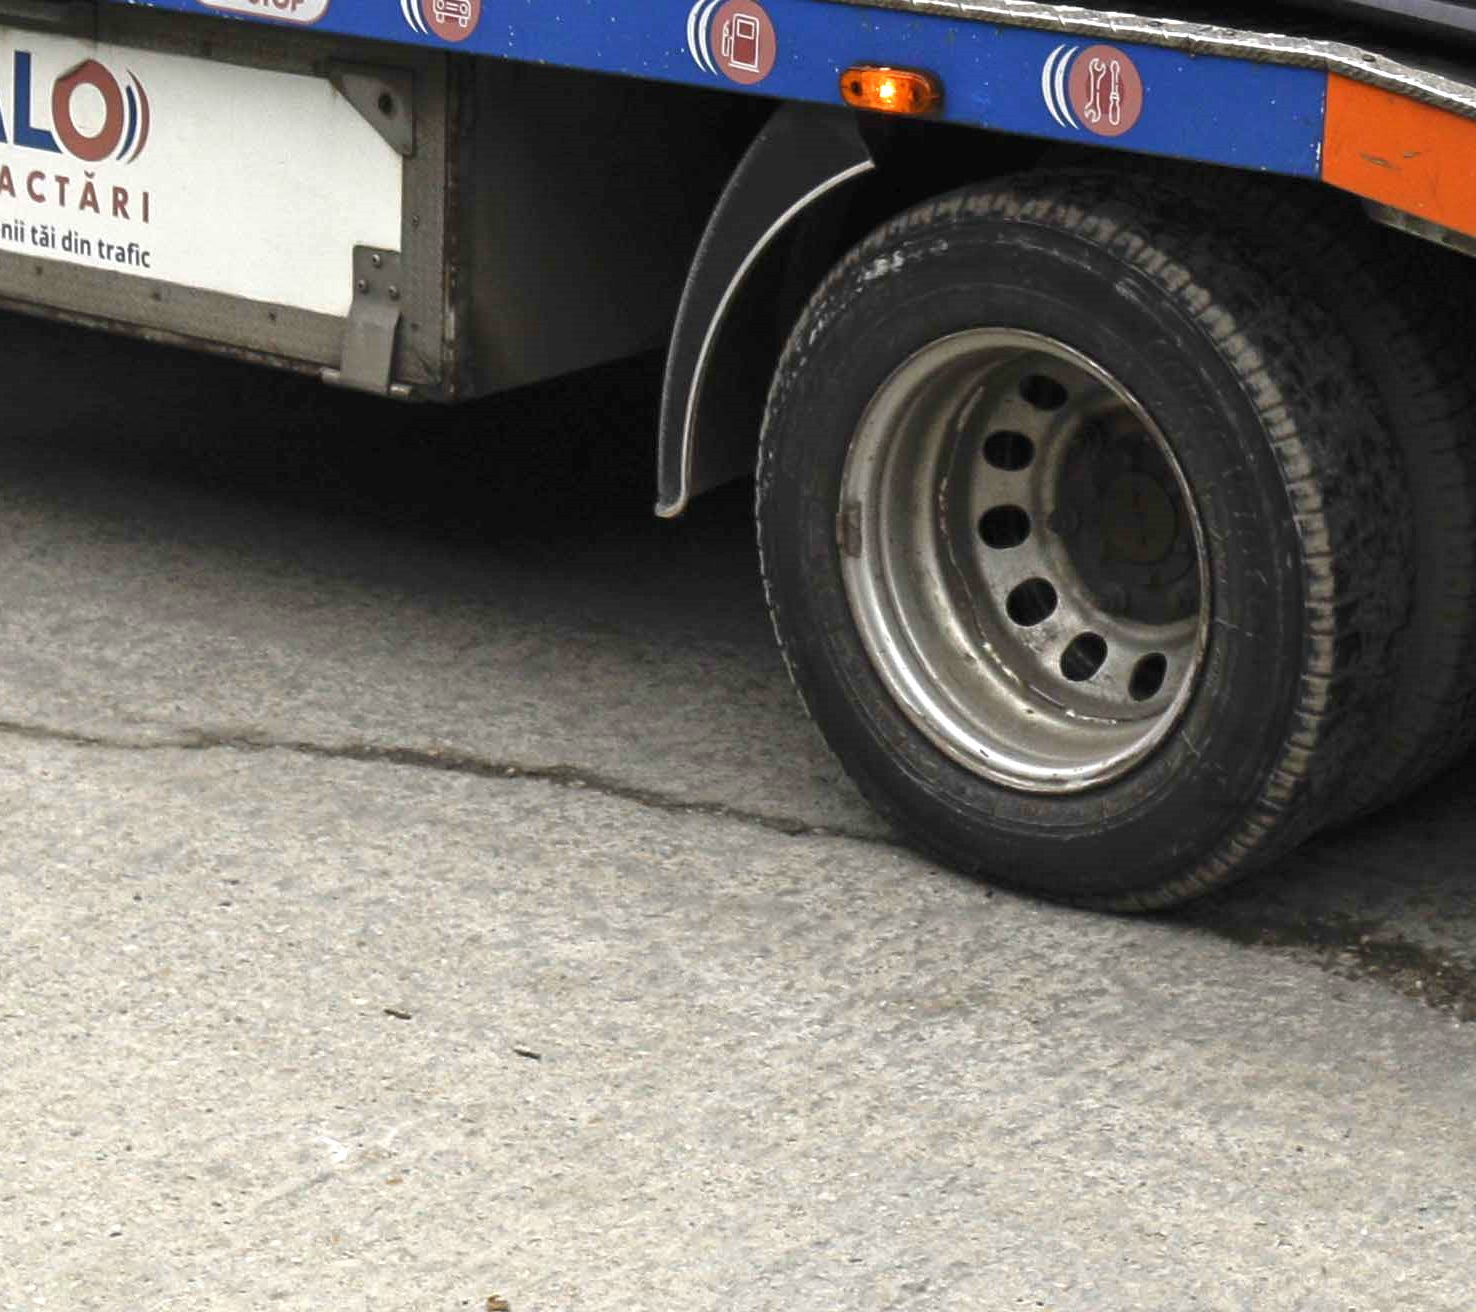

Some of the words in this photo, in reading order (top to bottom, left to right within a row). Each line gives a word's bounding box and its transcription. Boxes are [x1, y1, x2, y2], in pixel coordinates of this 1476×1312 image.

[30, 225, 57, 249] tăi
[61, 229, 92, 257] din
[97, 239, 152, 269] trafic
